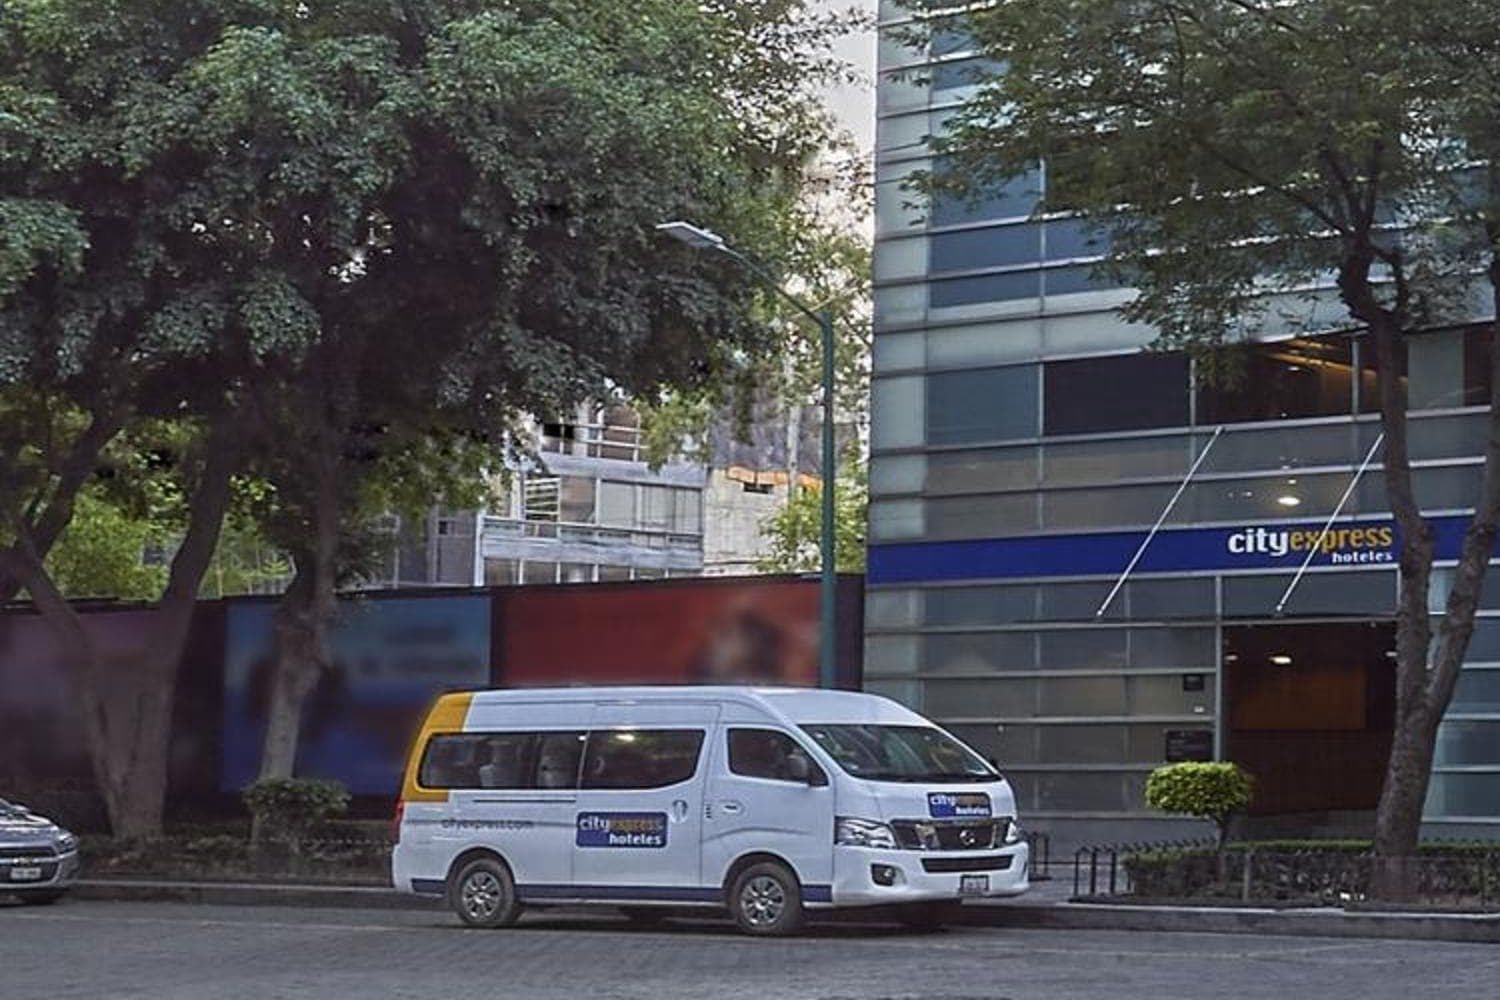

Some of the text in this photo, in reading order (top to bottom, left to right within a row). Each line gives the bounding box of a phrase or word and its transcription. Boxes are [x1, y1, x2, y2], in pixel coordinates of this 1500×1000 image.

[1227, 526, 1393, 557] cityexpress
[1331, 551, 1393, 564] hoteles
[609, 833, 662, 845] hoteles
